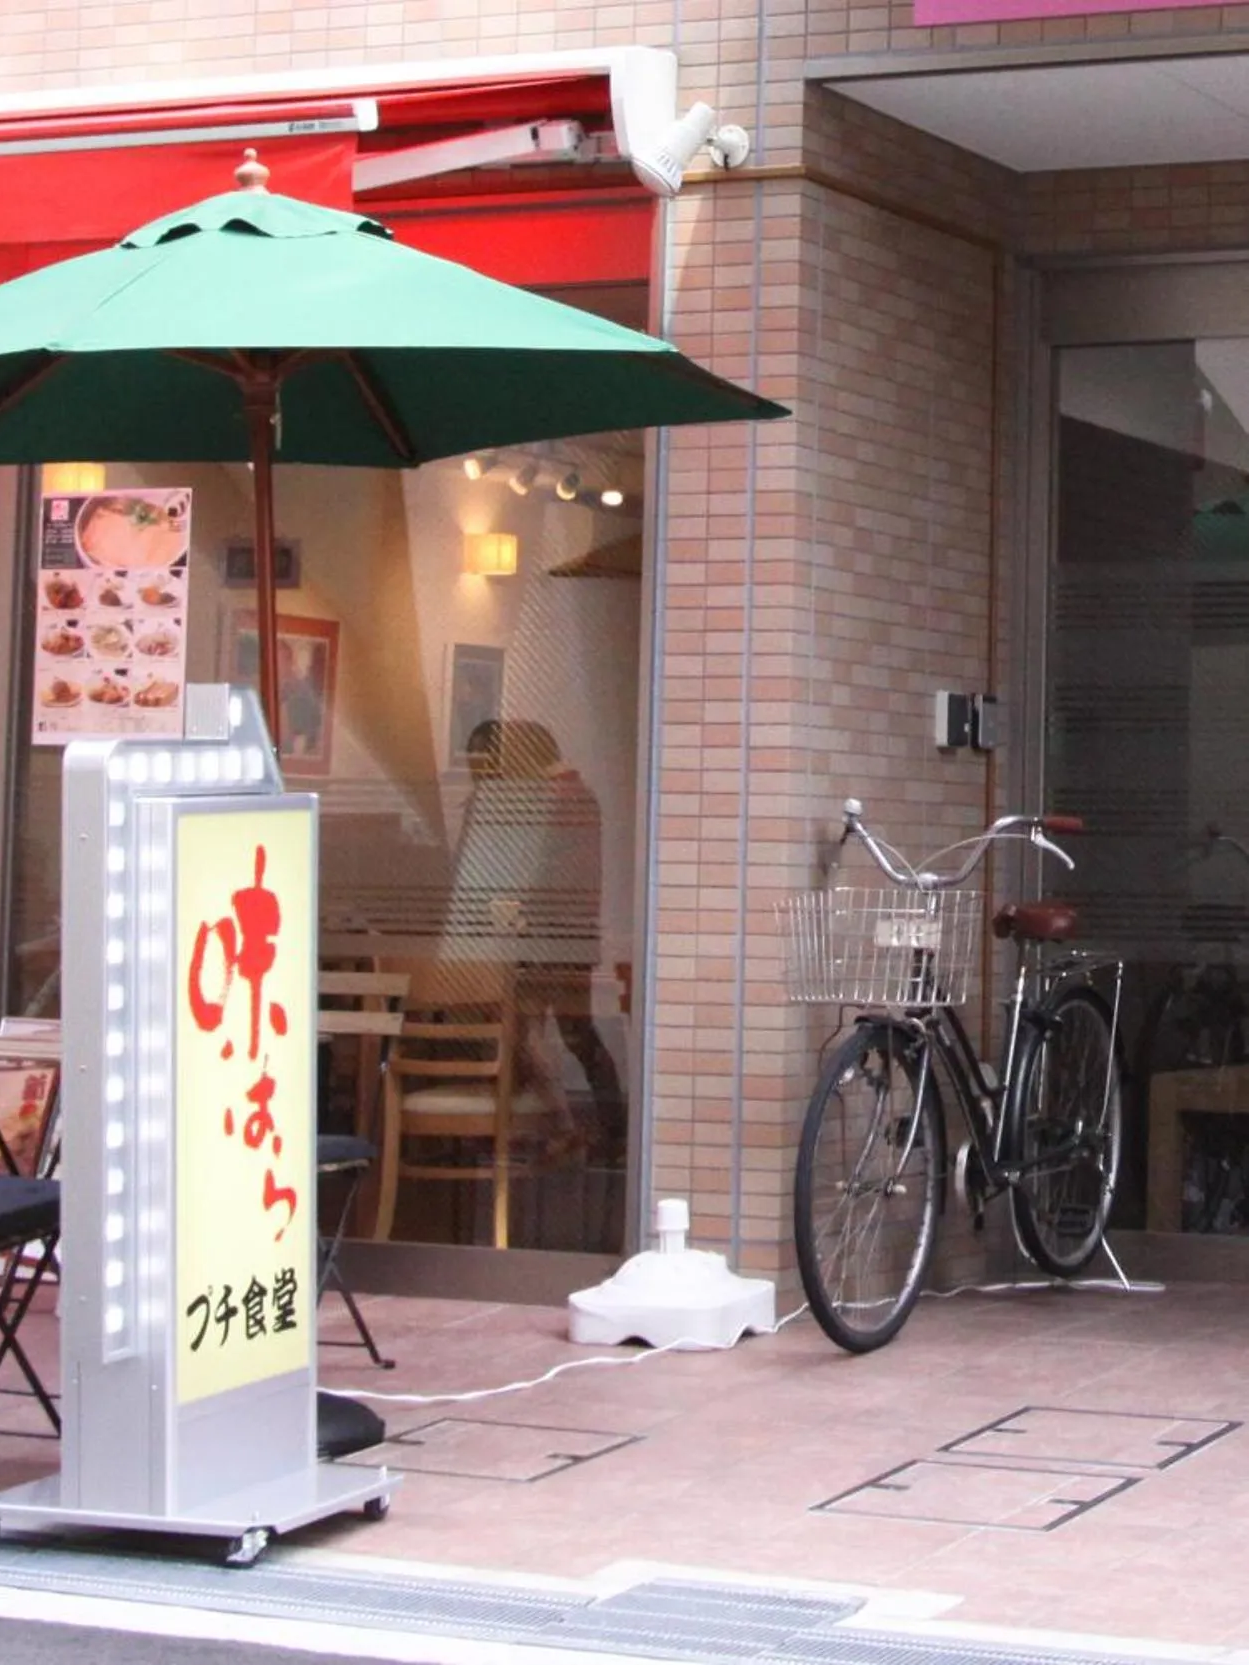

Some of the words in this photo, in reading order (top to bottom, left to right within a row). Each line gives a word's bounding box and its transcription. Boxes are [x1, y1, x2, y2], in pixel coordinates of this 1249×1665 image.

[189, 845, 297, 1242] 味はら
[186, 1267, 298, 1352] プチ食堂
